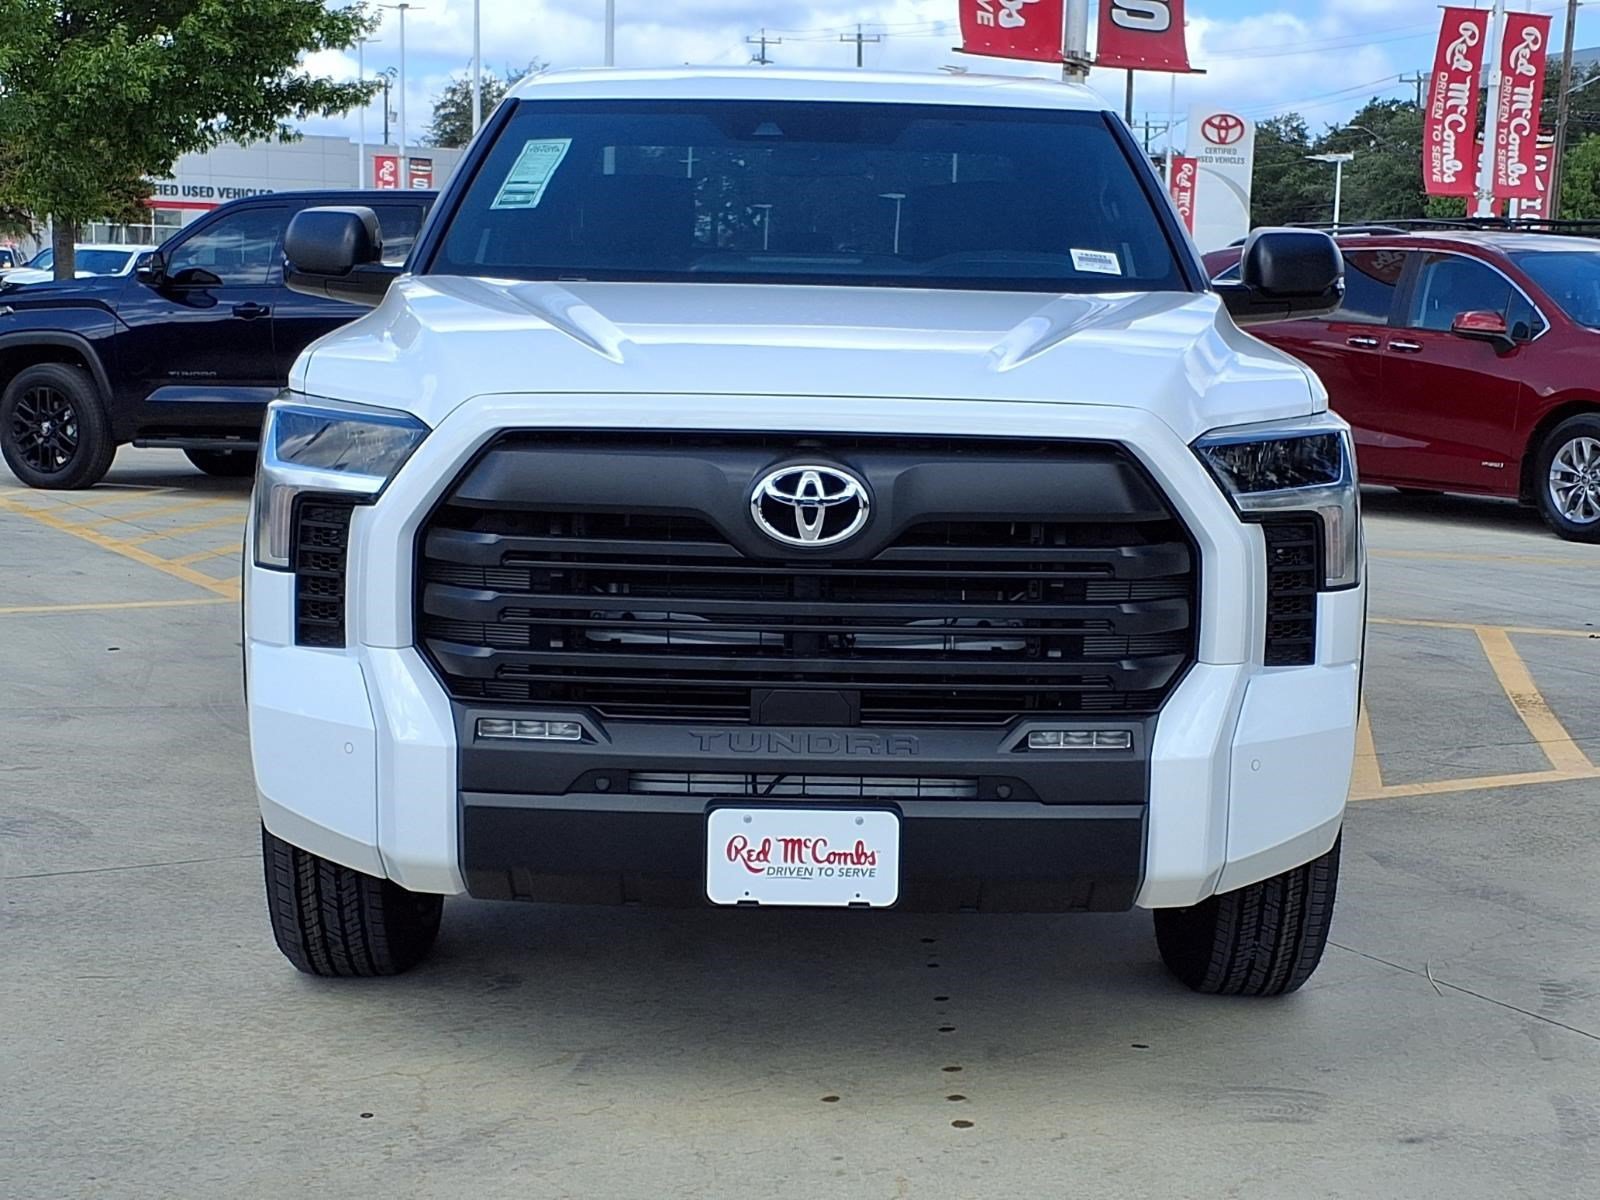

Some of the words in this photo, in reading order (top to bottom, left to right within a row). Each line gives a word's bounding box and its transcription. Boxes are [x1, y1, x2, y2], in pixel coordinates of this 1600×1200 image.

[1446, 21, 1479, 72] Red
[1509, 26, 1541, 76] Red
[1434, 72, 1448, 119] DRIVEN
[1500, 76, 1512, 122] DRIVEN
[1432, 124, 1442, 141] TO
[1443, 75, 1472, 183] McCombs
[1498, 128, 1507, 144] TO
[1508, 80, 1536, 186] McCombs
[1199, 155, 1213, 163] SED
[1215, 156, 1245, 164] VEHICLES
[1204, 147, 1237, 155] CERTIFIED
[1431, 145, 1441, 183] SERVE
[1497, 149, 1507, 185] SERVE
[153, 184, 178, 196] FIED
[182, 185, 214, 198] USED
[1176, 163, 1193, 188] Red
[688, 729, 920, 756] TUNDRA
[726, 835, 771, 873] Red
[776, 837, 877, 866] McCombs
[766, 866, 813, 877] DRIVEN
[818, 867, 833, 877] TO
[837, 868, 876, 878] SERVE
